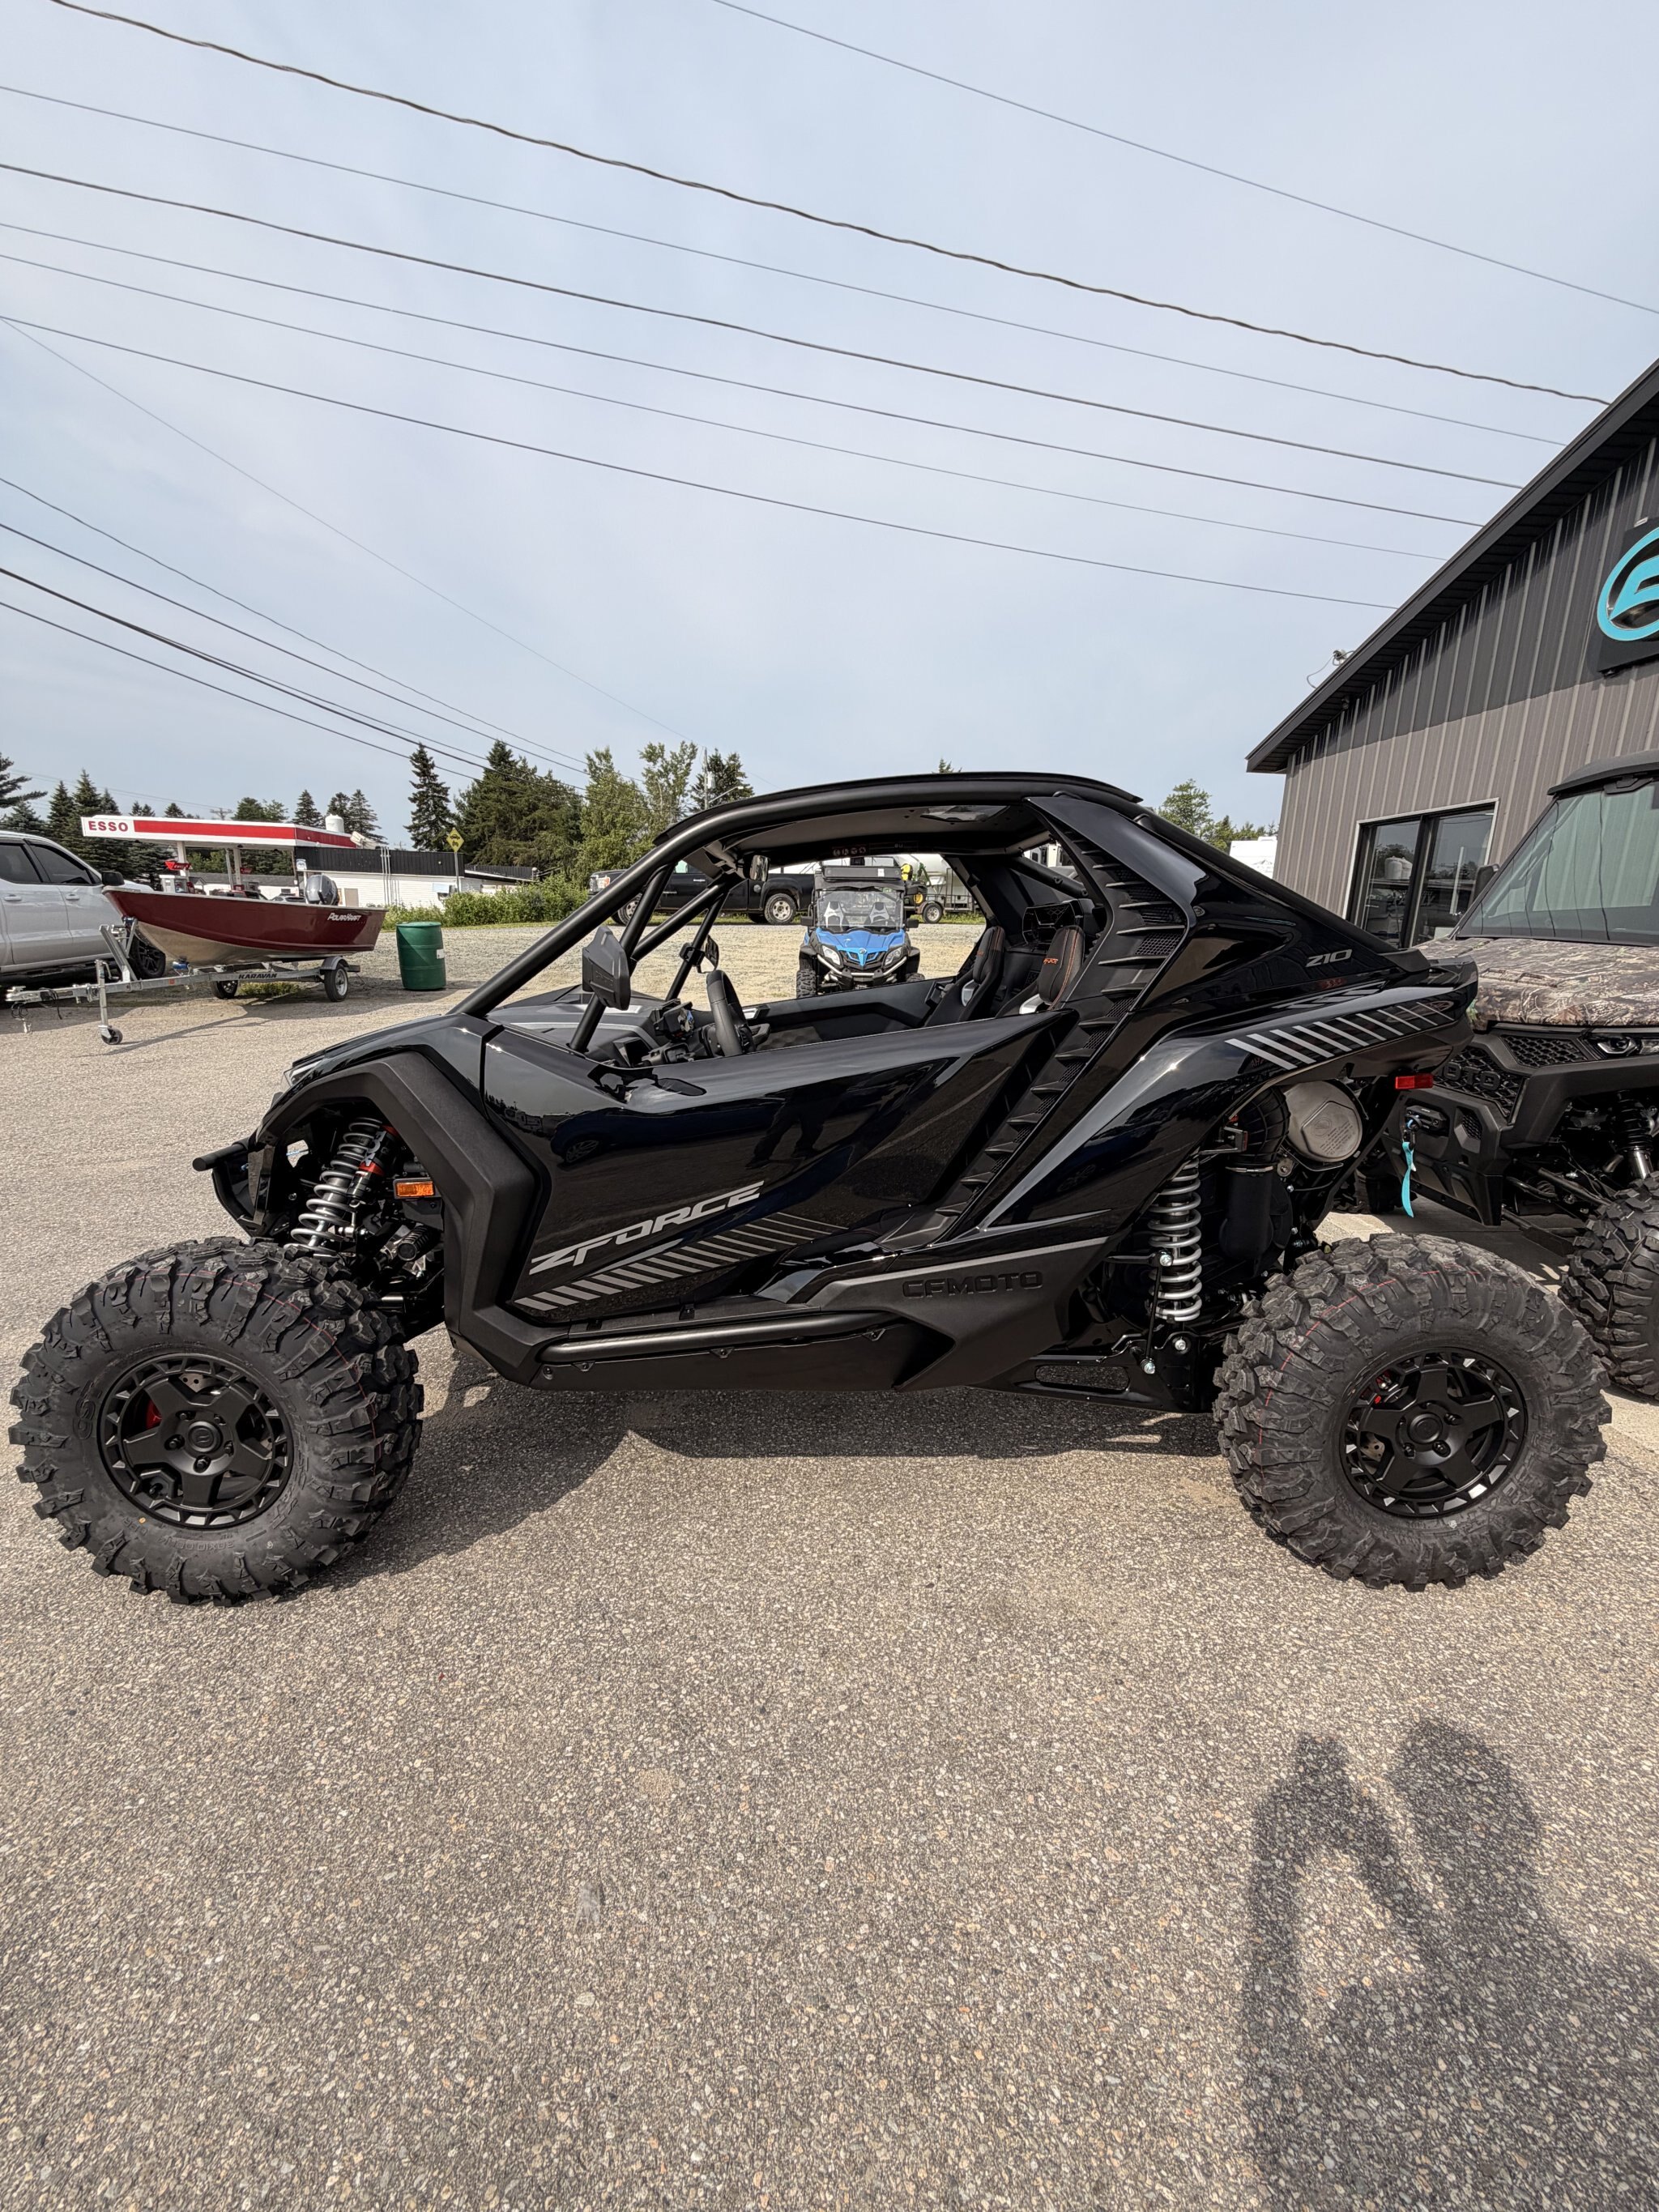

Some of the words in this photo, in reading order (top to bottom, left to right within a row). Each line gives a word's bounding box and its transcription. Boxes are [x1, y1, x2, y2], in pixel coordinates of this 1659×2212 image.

[88, 820, 128, 832] ESSO
[1305, 948, 1352, 967] Z10
[529, 1180, 764, 1275] ZFORCE
[902, 1271, 1043, 1298] CFMOTO
